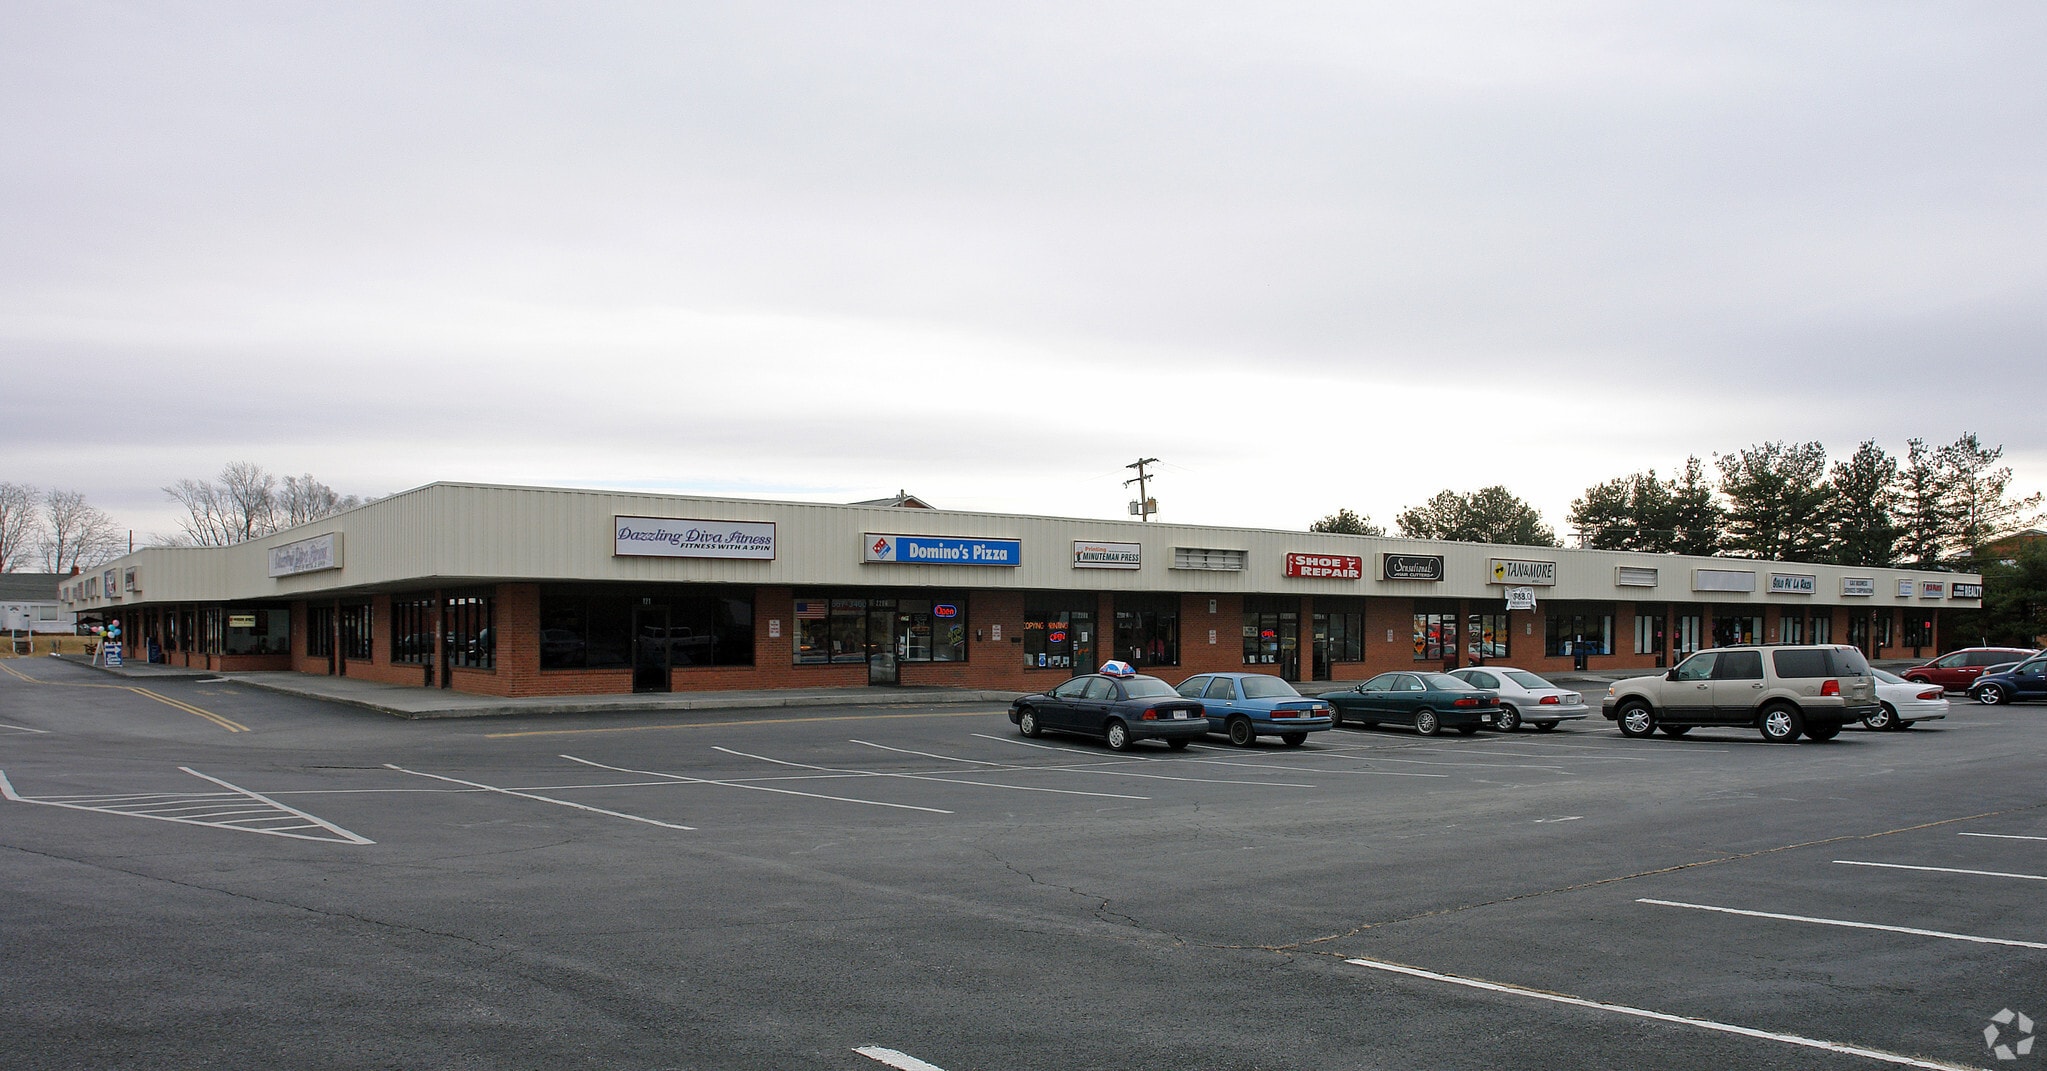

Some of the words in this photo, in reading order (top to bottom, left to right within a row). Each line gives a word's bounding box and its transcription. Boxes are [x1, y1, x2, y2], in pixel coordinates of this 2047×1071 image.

[617, 526, 683, 545] Dazzling
[685, 528, 723, 543] Diva
[724, 530, 772, 545] Fitness
[717, 543, 741, 551] WITH
[909, 542, 969, 560] Domino's
[973, 544, 1008, 561] Pizza
[1082, 552, 1120, 561] MINUTEMAN
[1120, 553, 1139, 562] PRESS
[1295, 555, 1341, 567] SHOE
[1300, 566, 1359, 578] REPAIR
[1507, 562, 1553, 578] TAN&MORE
[1964, 585, 1983, 598] REALTY
